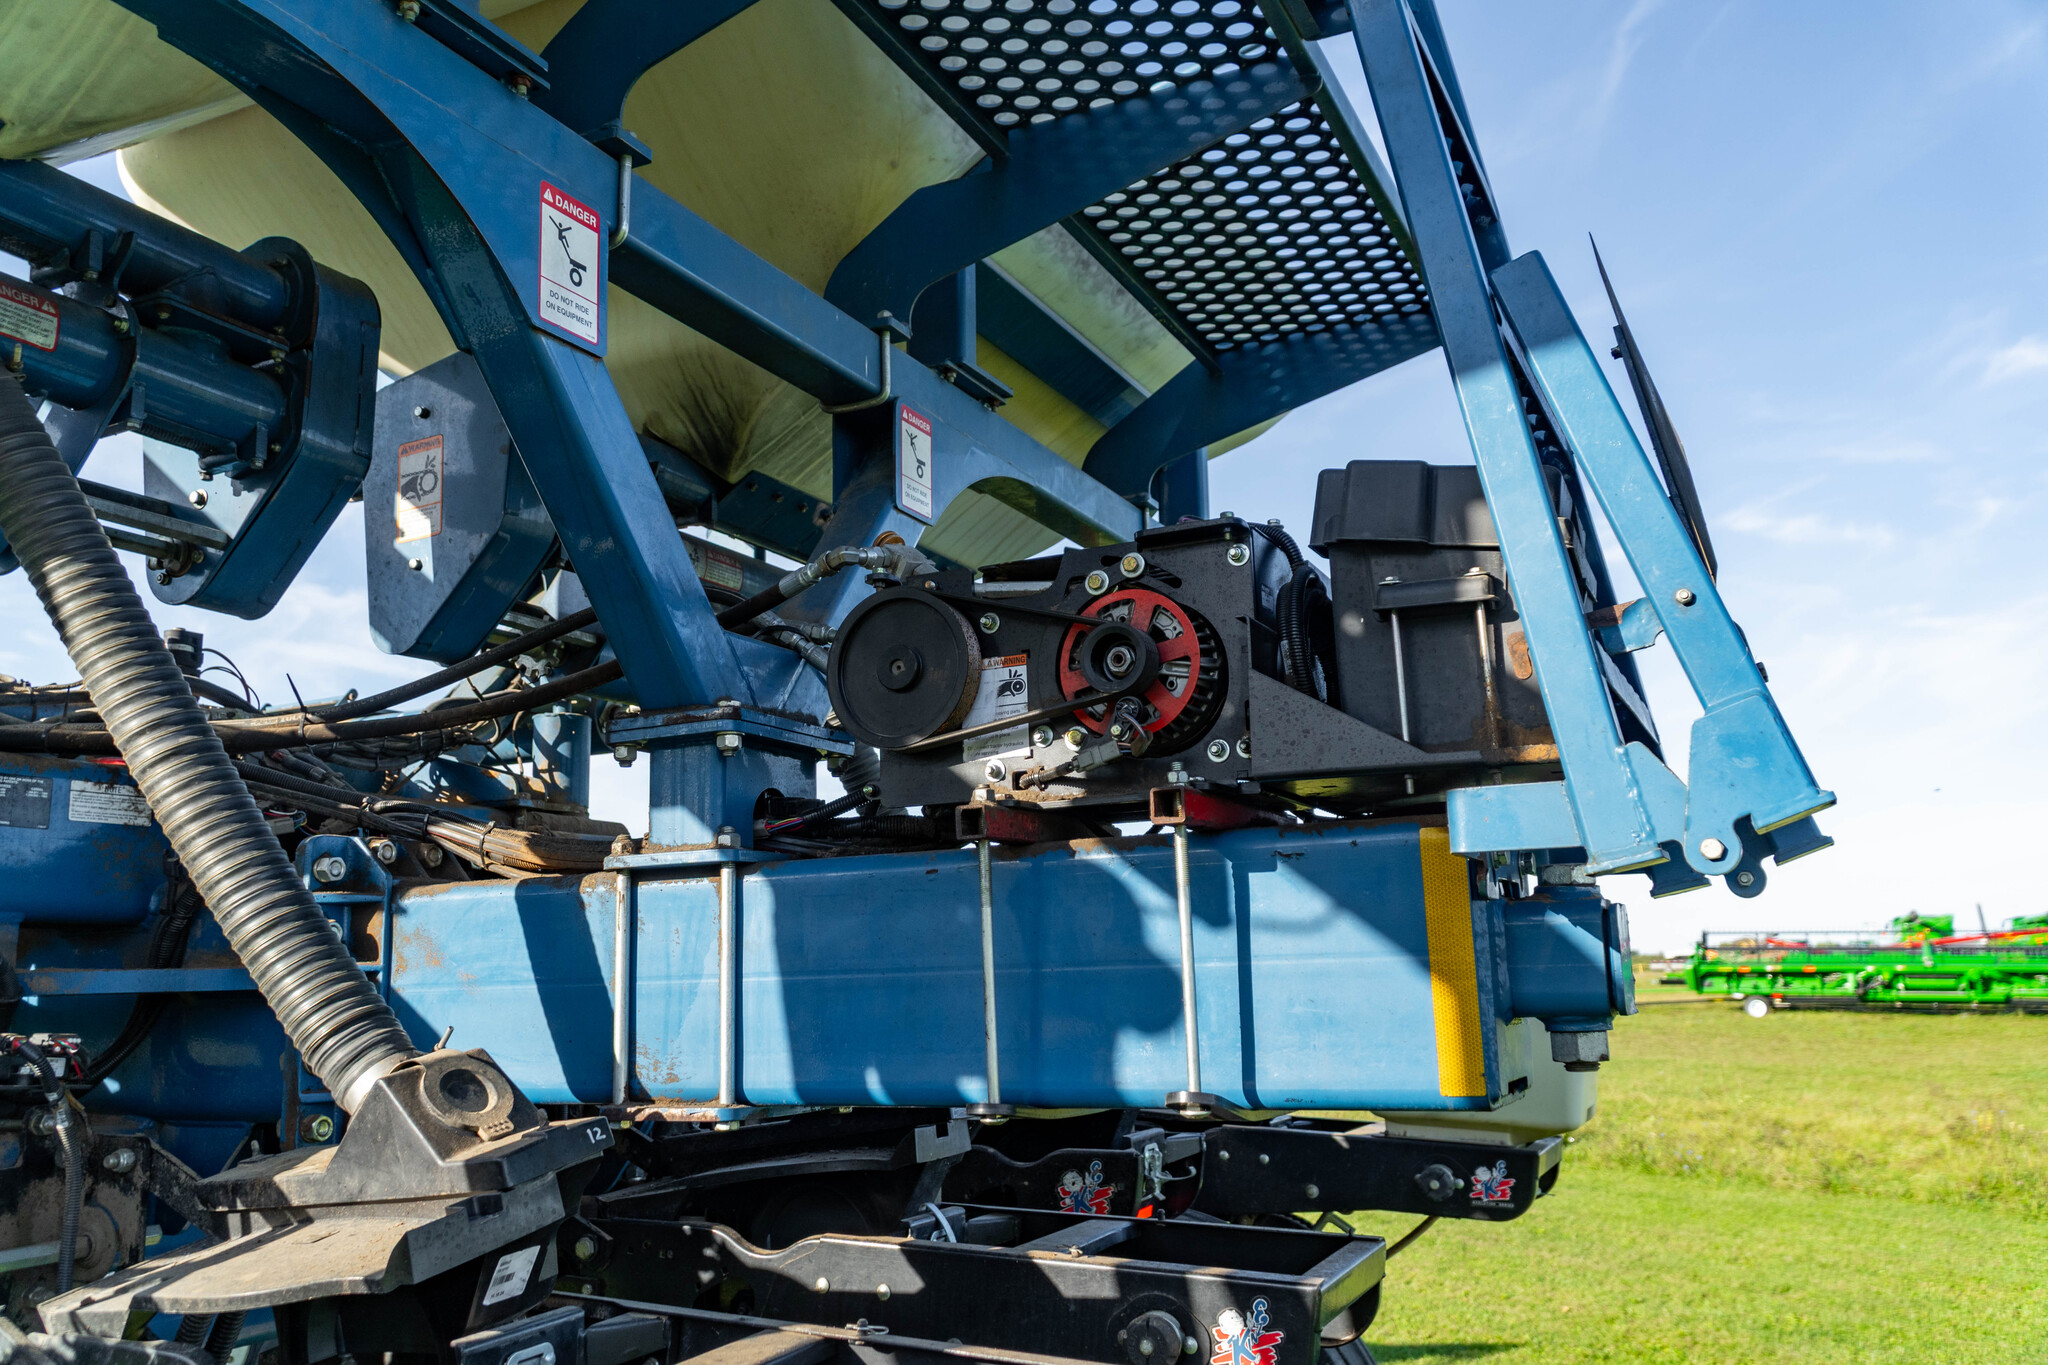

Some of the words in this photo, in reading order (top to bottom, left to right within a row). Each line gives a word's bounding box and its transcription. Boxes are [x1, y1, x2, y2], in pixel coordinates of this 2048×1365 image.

[555, 194, 597, 228] DANGER
[0, 285, 39, 307] NGER
[549, 289, 560, 300] DO
[560, 295, 574, 307] NOT
[574, 302, 590, 316] RIDE
[545, 300, 556, 311] ON
[556, 305, 593, 329] EQUIPMENT
[908, 413, 931, 433] DANGER
[994, 655, 1026, 668] WARNING
[586, 1127, 606, 1144] 12
